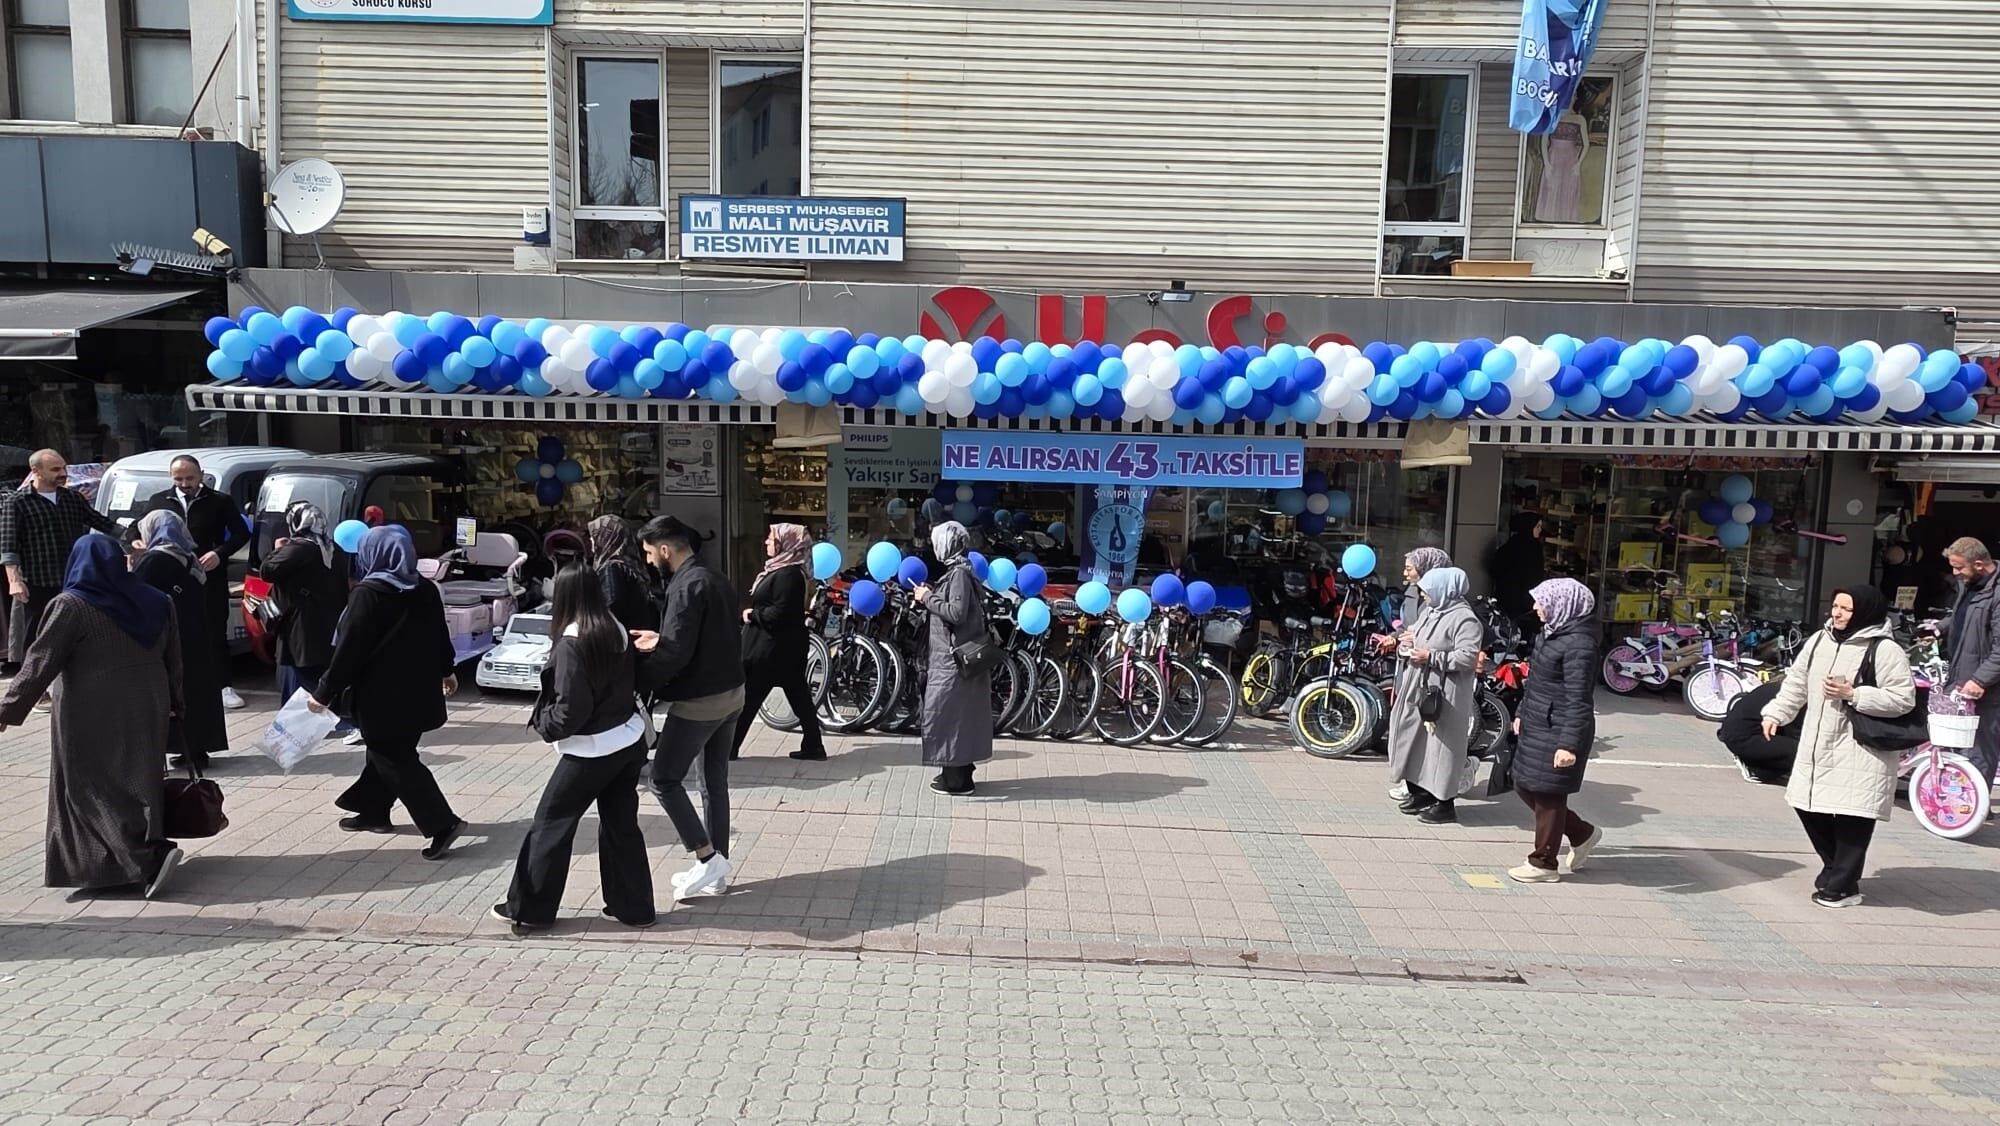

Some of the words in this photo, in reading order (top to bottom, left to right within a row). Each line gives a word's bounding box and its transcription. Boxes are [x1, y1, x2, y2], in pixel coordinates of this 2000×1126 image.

[397, 0, 432, 9] KURSU
[729, 204, 793, 215] SERBEST
[807, 237, 889, 256] ILIMAN
[850, 433, 889, 443] PHILIPS
[895, 458, 906, 466] En
[944, 445, 980, 469] NE
[985, 446, 1101, 472] ALIRSAN
[1104, 441, 1160, 480] 43
[1160, 462, 1177, 475] TL
[1176, 445, 1302, 477] TAKSİTLE
[845, 466, 905, 487] Yakışır
[1094, 488, 1148, 500] ŞAMPİYON
